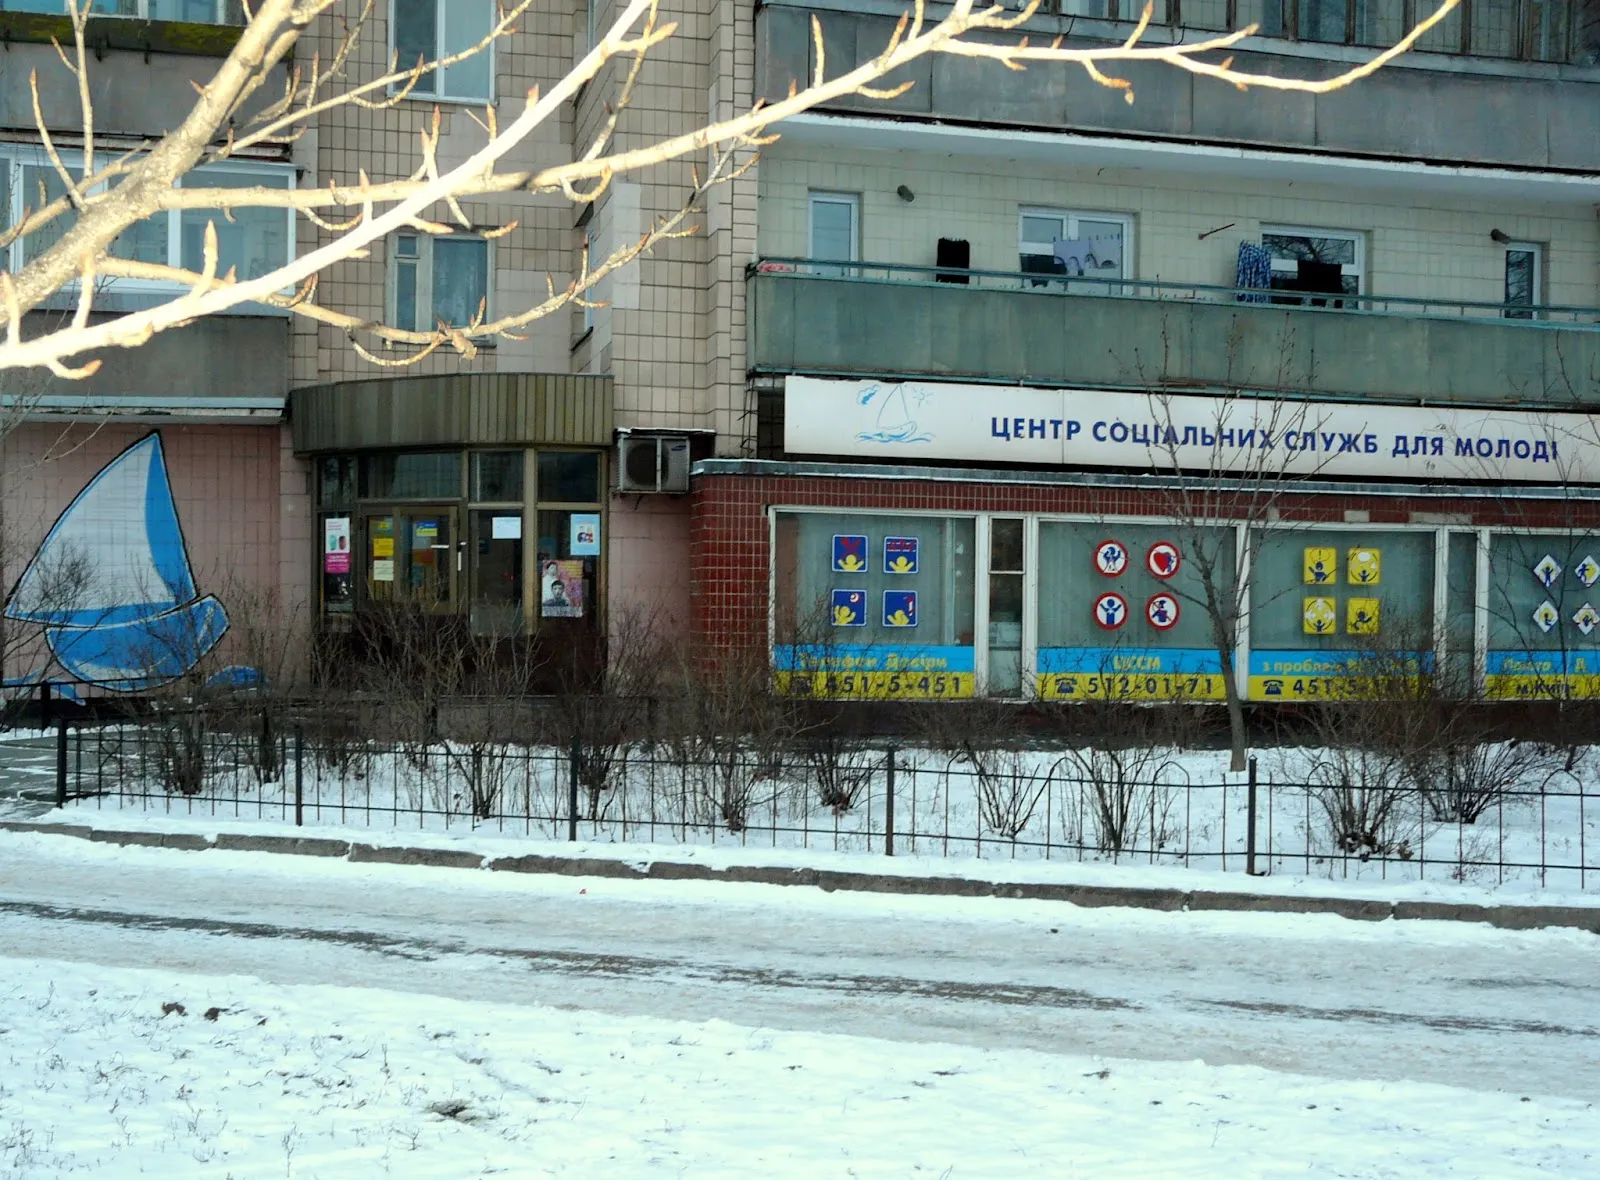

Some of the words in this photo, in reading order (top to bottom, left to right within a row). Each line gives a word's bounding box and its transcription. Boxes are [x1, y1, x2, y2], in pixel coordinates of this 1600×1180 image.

[991, 417, 1082, 441] ЦЕНТР
[1091, 420, 1275, 450] СОЦІАЛЬНИХ
[1284, 429, 1378, 453] СЛУЖБ
[1391, 434, 1444, 458] ДЛЯ
[1454, 436, 1557, 462] МОЛОДІ
[1087, 676, 1213, 694] 512-01-71
